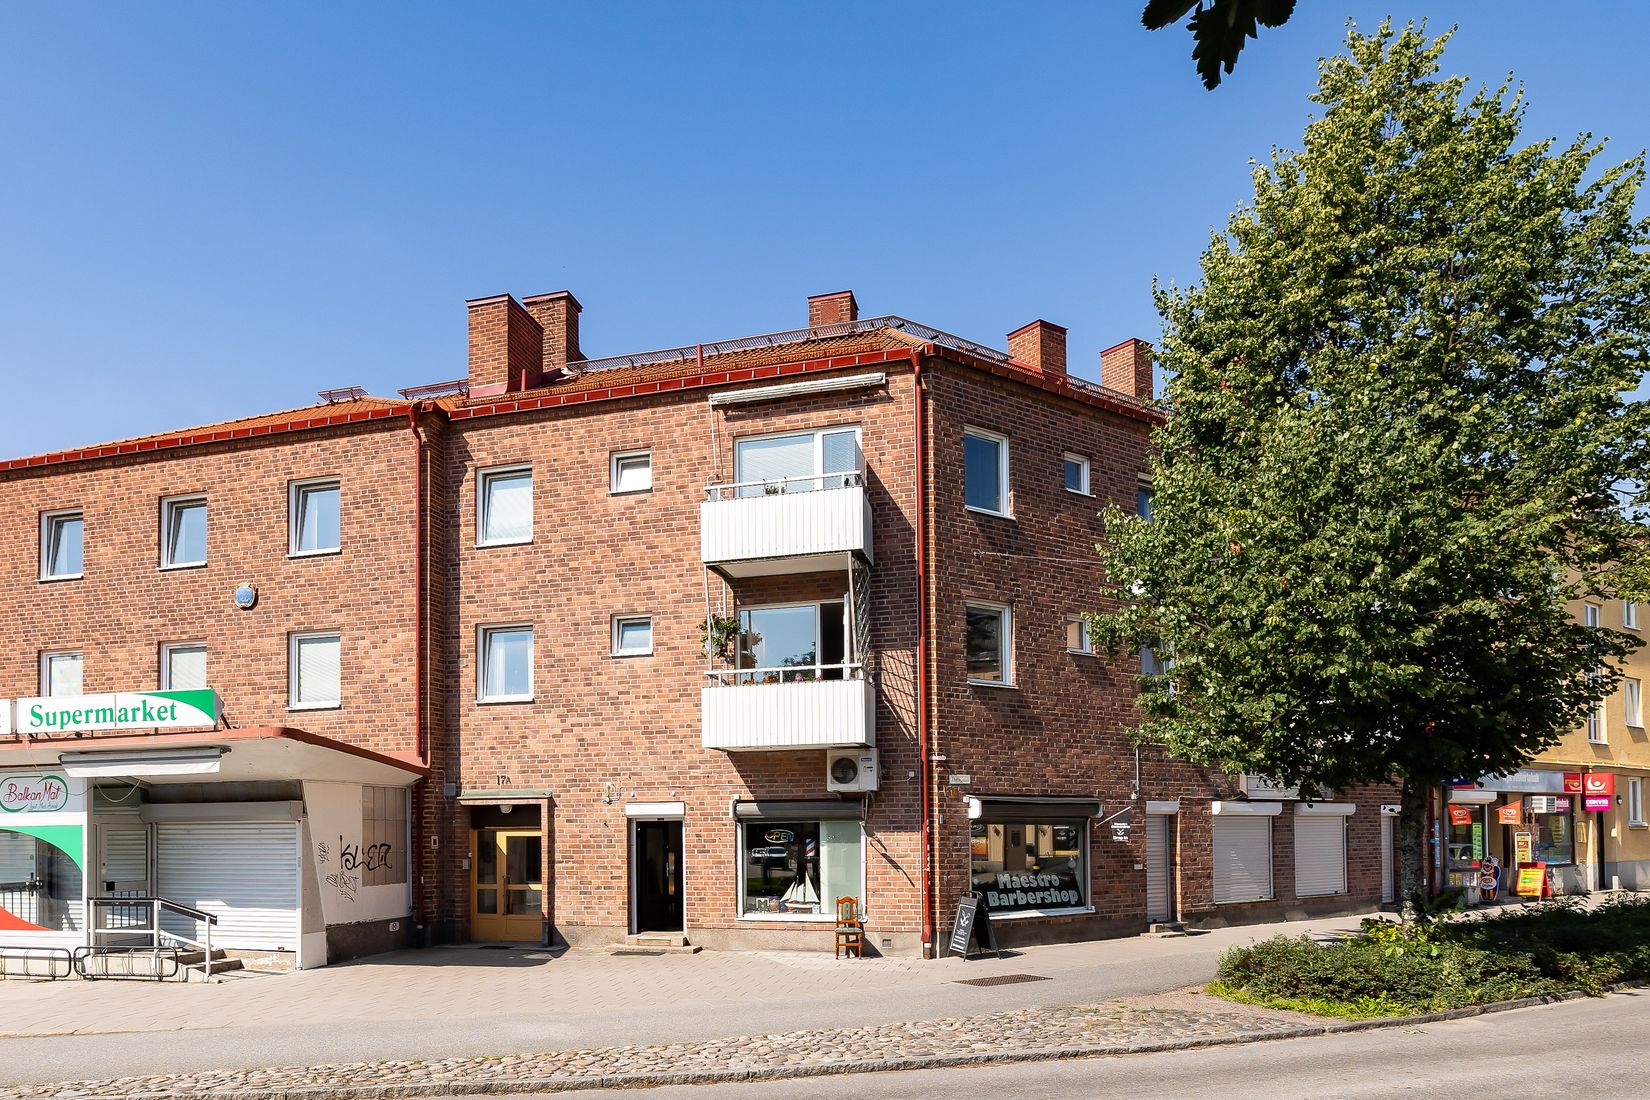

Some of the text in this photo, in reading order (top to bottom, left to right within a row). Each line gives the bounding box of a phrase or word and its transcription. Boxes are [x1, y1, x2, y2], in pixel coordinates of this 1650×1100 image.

[30, 699, 177, 730] Supermarket
[496, 775, 512, 786] 17A
[3, 782, 61, 803] Balkan Mat
[997, 873, 1060, 889] Maestro
[986, 888, 1079, 907] Barbershop
